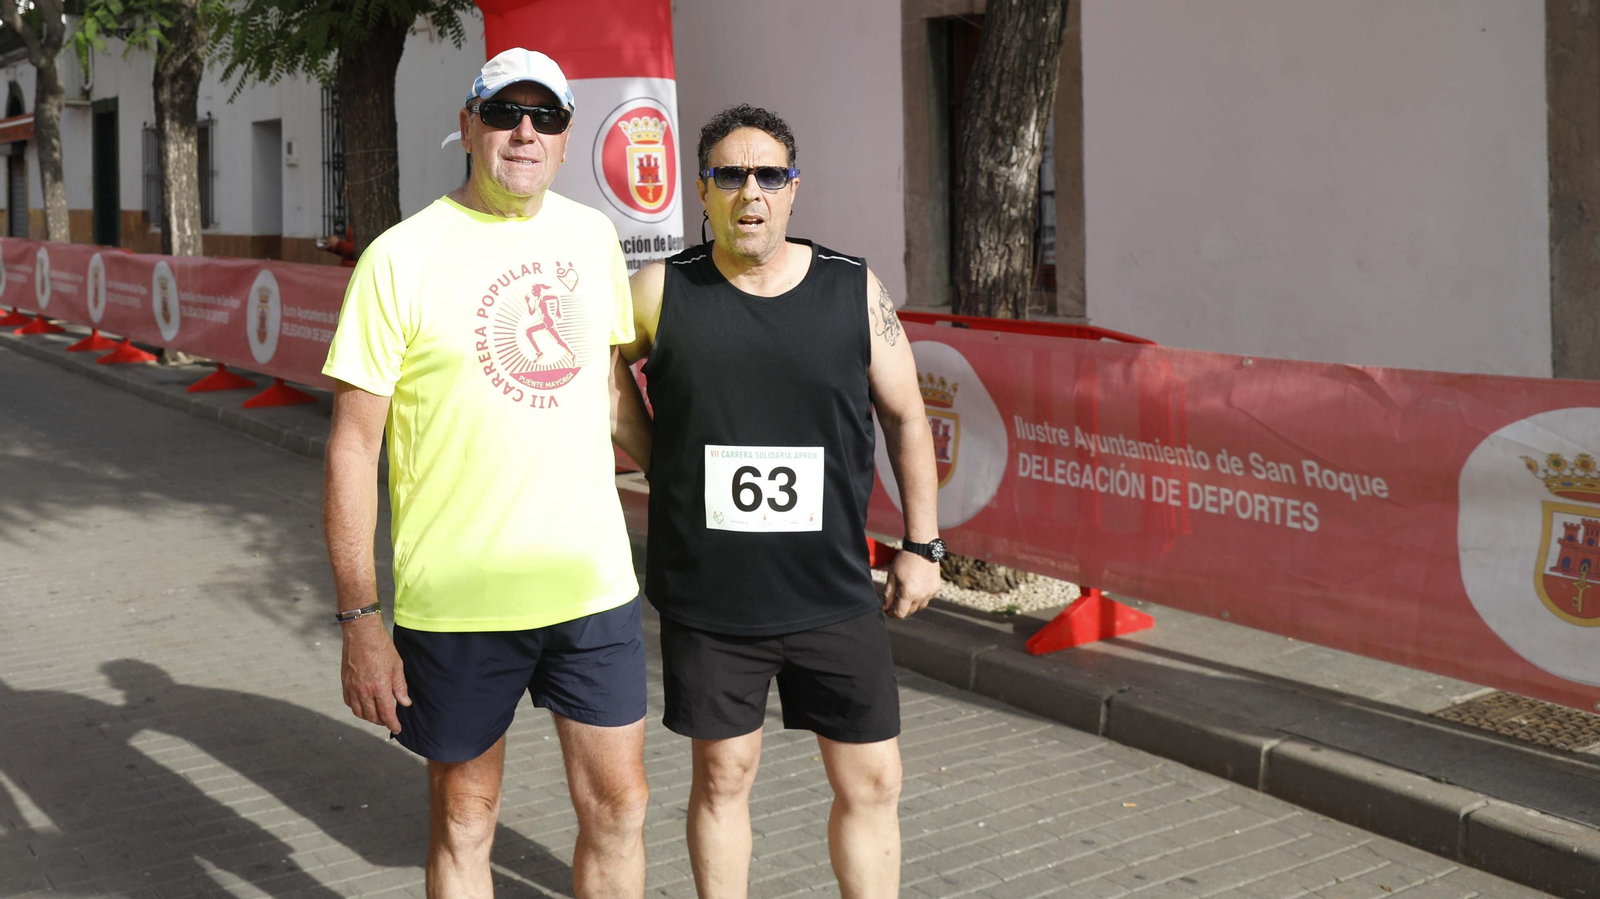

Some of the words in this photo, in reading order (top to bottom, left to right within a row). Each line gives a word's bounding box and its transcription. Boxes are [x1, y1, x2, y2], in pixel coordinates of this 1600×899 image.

[654, 235, 666, 252] de
[476, 262, 543, 319] POPULAR
[474, 326, 524, 402] CARRERA
[519, 375, 545, 389] PUENTE
[530, 395, 559, 409] VII
[710, 450, 719, 458] VII
[721, 450, 753, 459] CARRERA
[755, 451, 792, 459] SOLIDARIA
[1013, 415, 1070, 447] Ilustre
[1074, 425, 1211, 472] Ayuntamiento
[1216, 448, 1245, 476] de
[1249, 452, 1297, 484] San
[1302, 460, 1389, 501] Roque
[731, 465, 798, 512] 63
[1018, 452, 1145, 500] DELEGACIÓN
[1152, 475, 1182, 507] DE
[1188, 481, 1320, 532] DEPORTES
